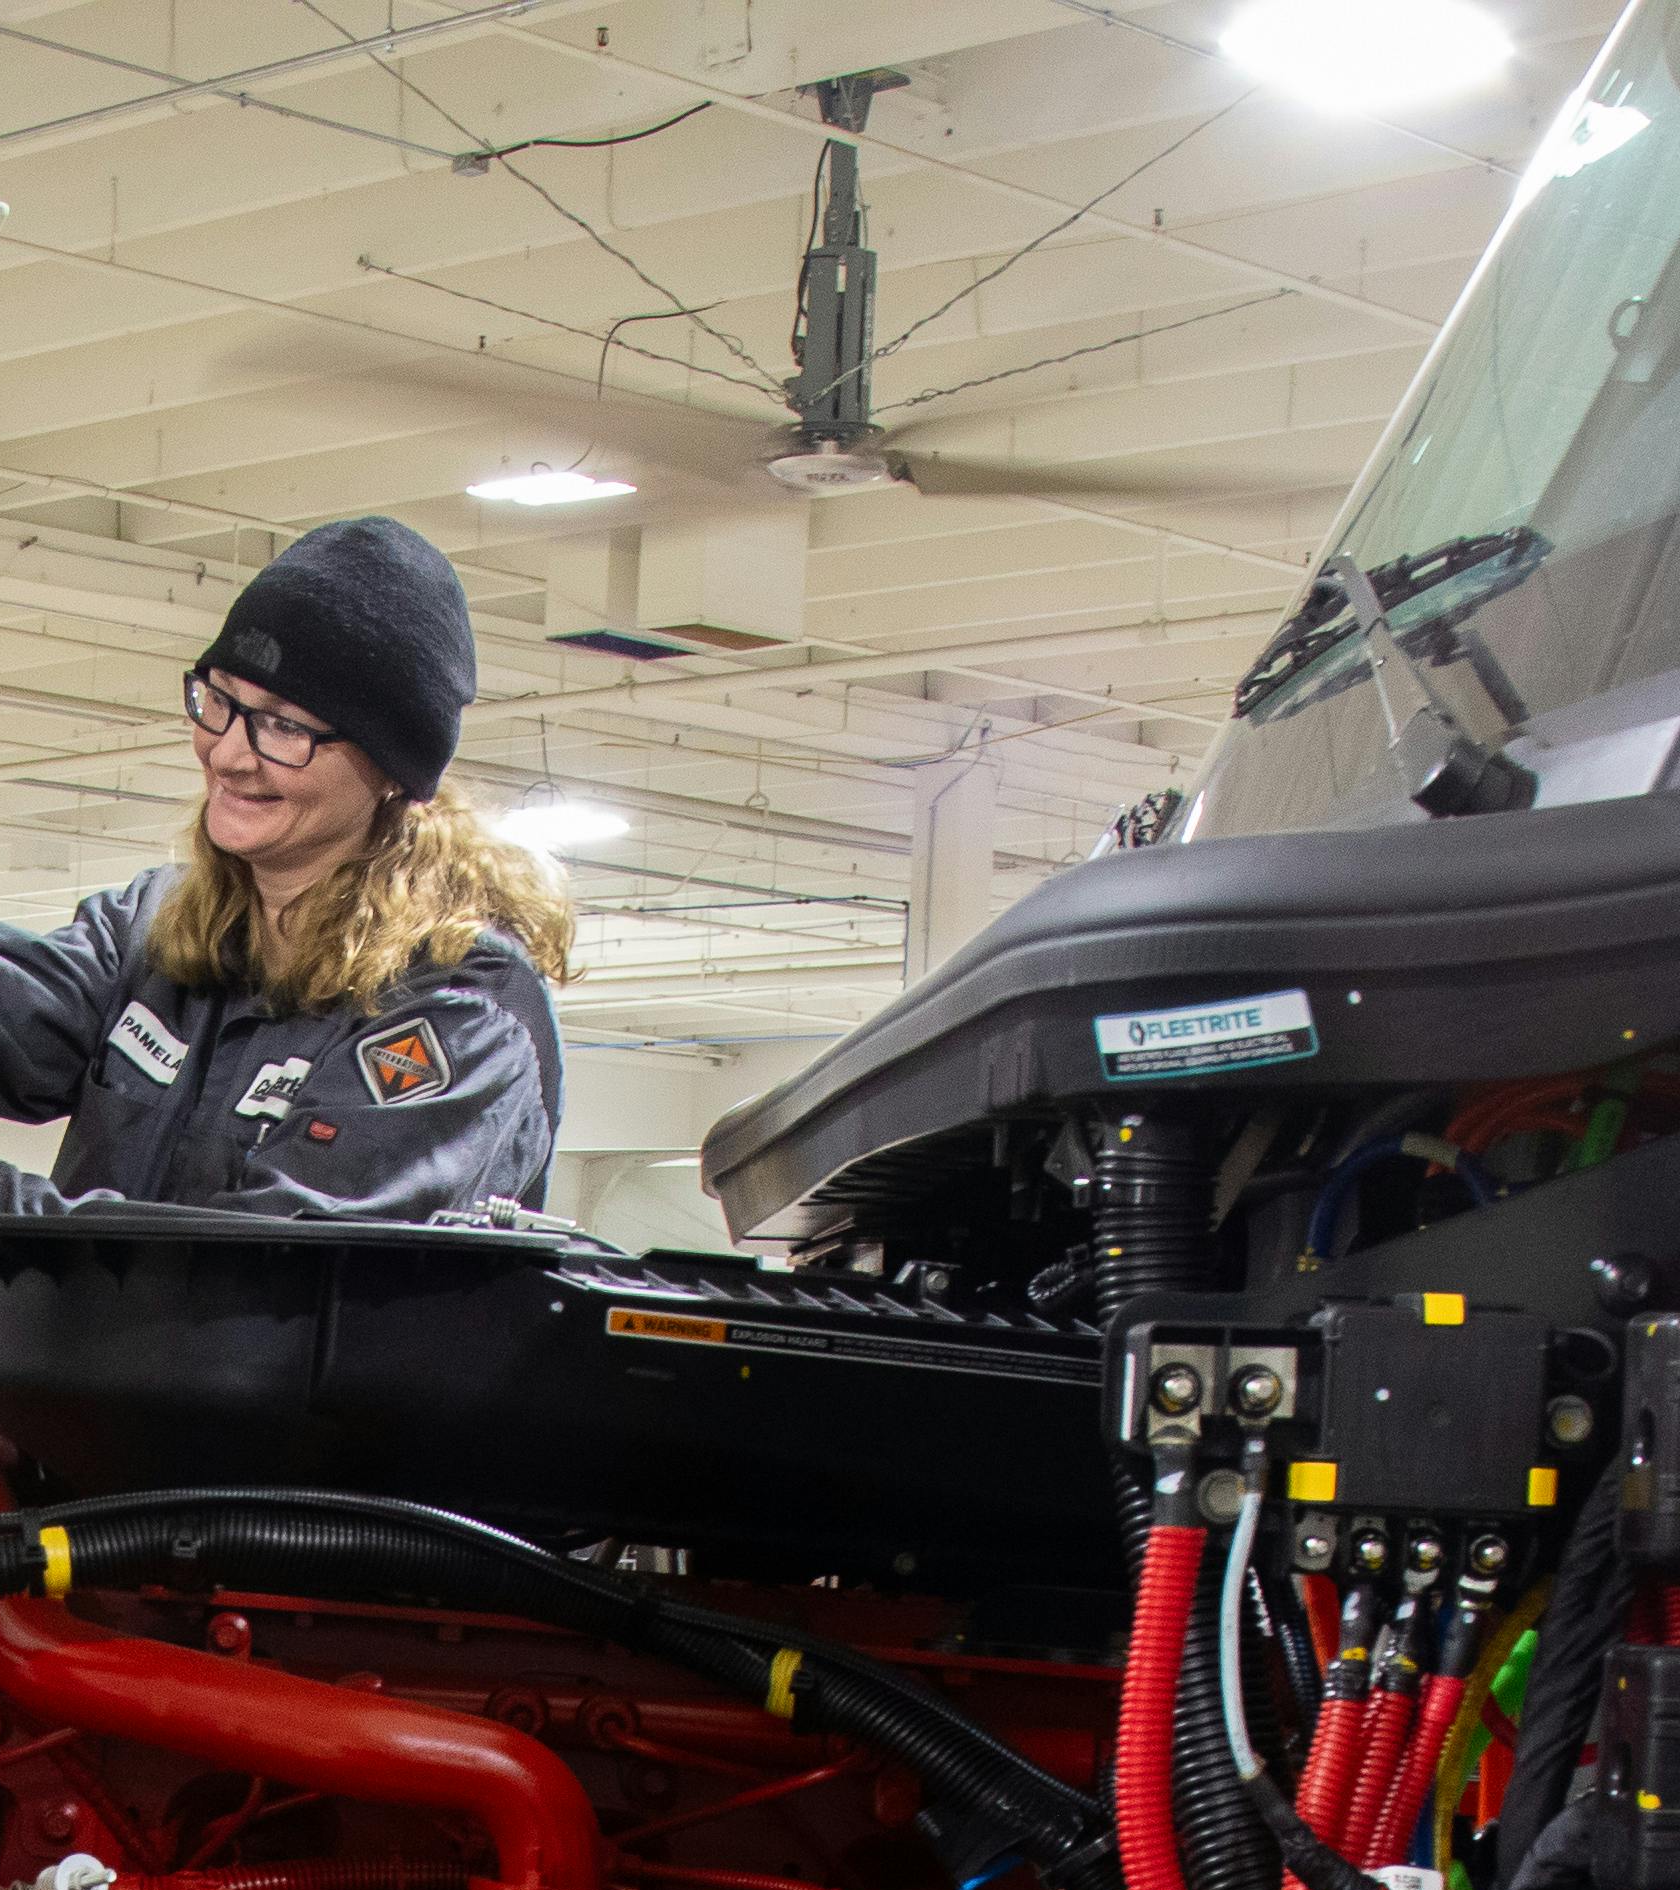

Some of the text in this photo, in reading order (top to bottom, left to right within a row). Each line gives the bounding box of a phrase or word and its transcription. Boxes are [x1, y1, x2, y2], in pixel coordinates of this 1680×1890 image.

[1146, 1007, 1261, 1040] FLEETRITE
[120, 1015, 182, 1074] PAMELA
[643, 1317, 829, 1348] WARNING EXPLOSION HAZARD
